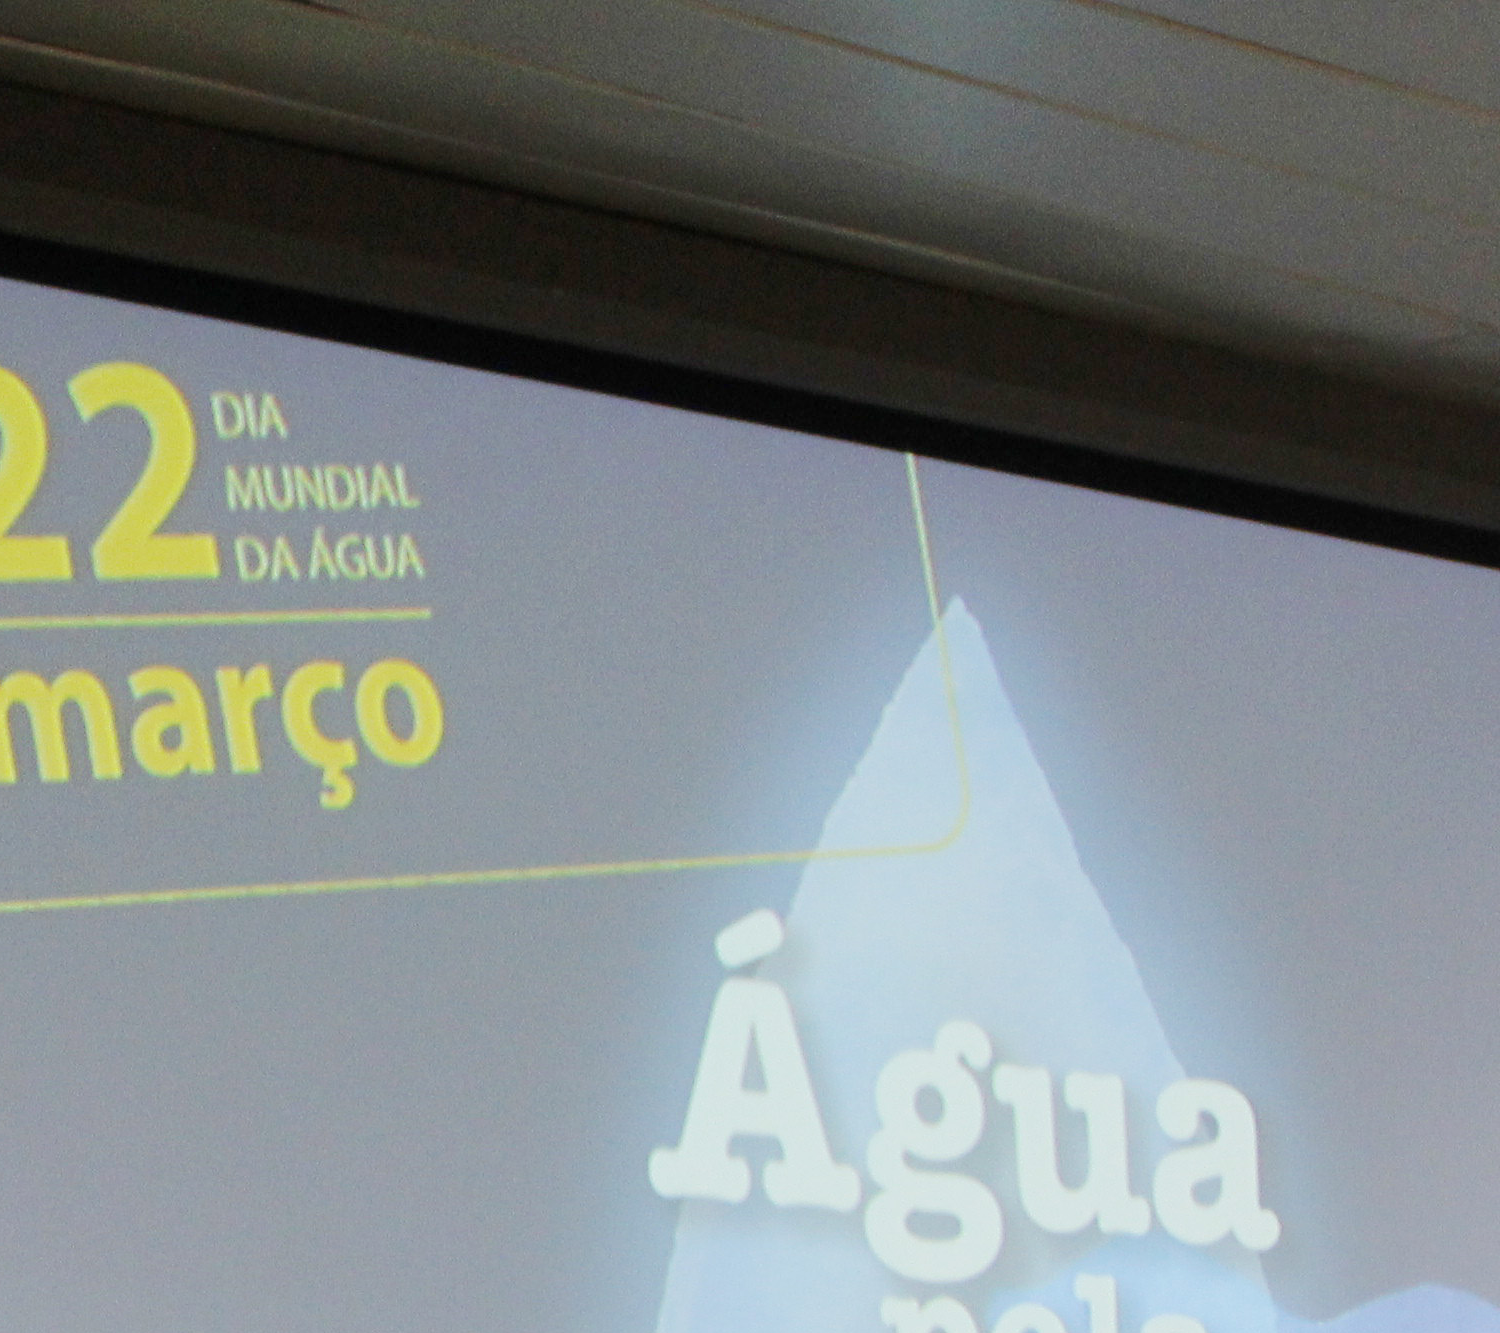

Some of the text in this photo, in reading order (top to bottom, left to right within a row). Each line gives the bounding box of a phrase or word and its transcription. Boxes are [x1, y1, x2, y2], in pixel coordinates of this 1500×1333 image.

[211, 391, 288, 439] DIA
[225, 463, 421, 512] MUNDIAL
[235, 526, 425, 582] DA ÁGUA
[648, 908, 1281, 1283] Água
